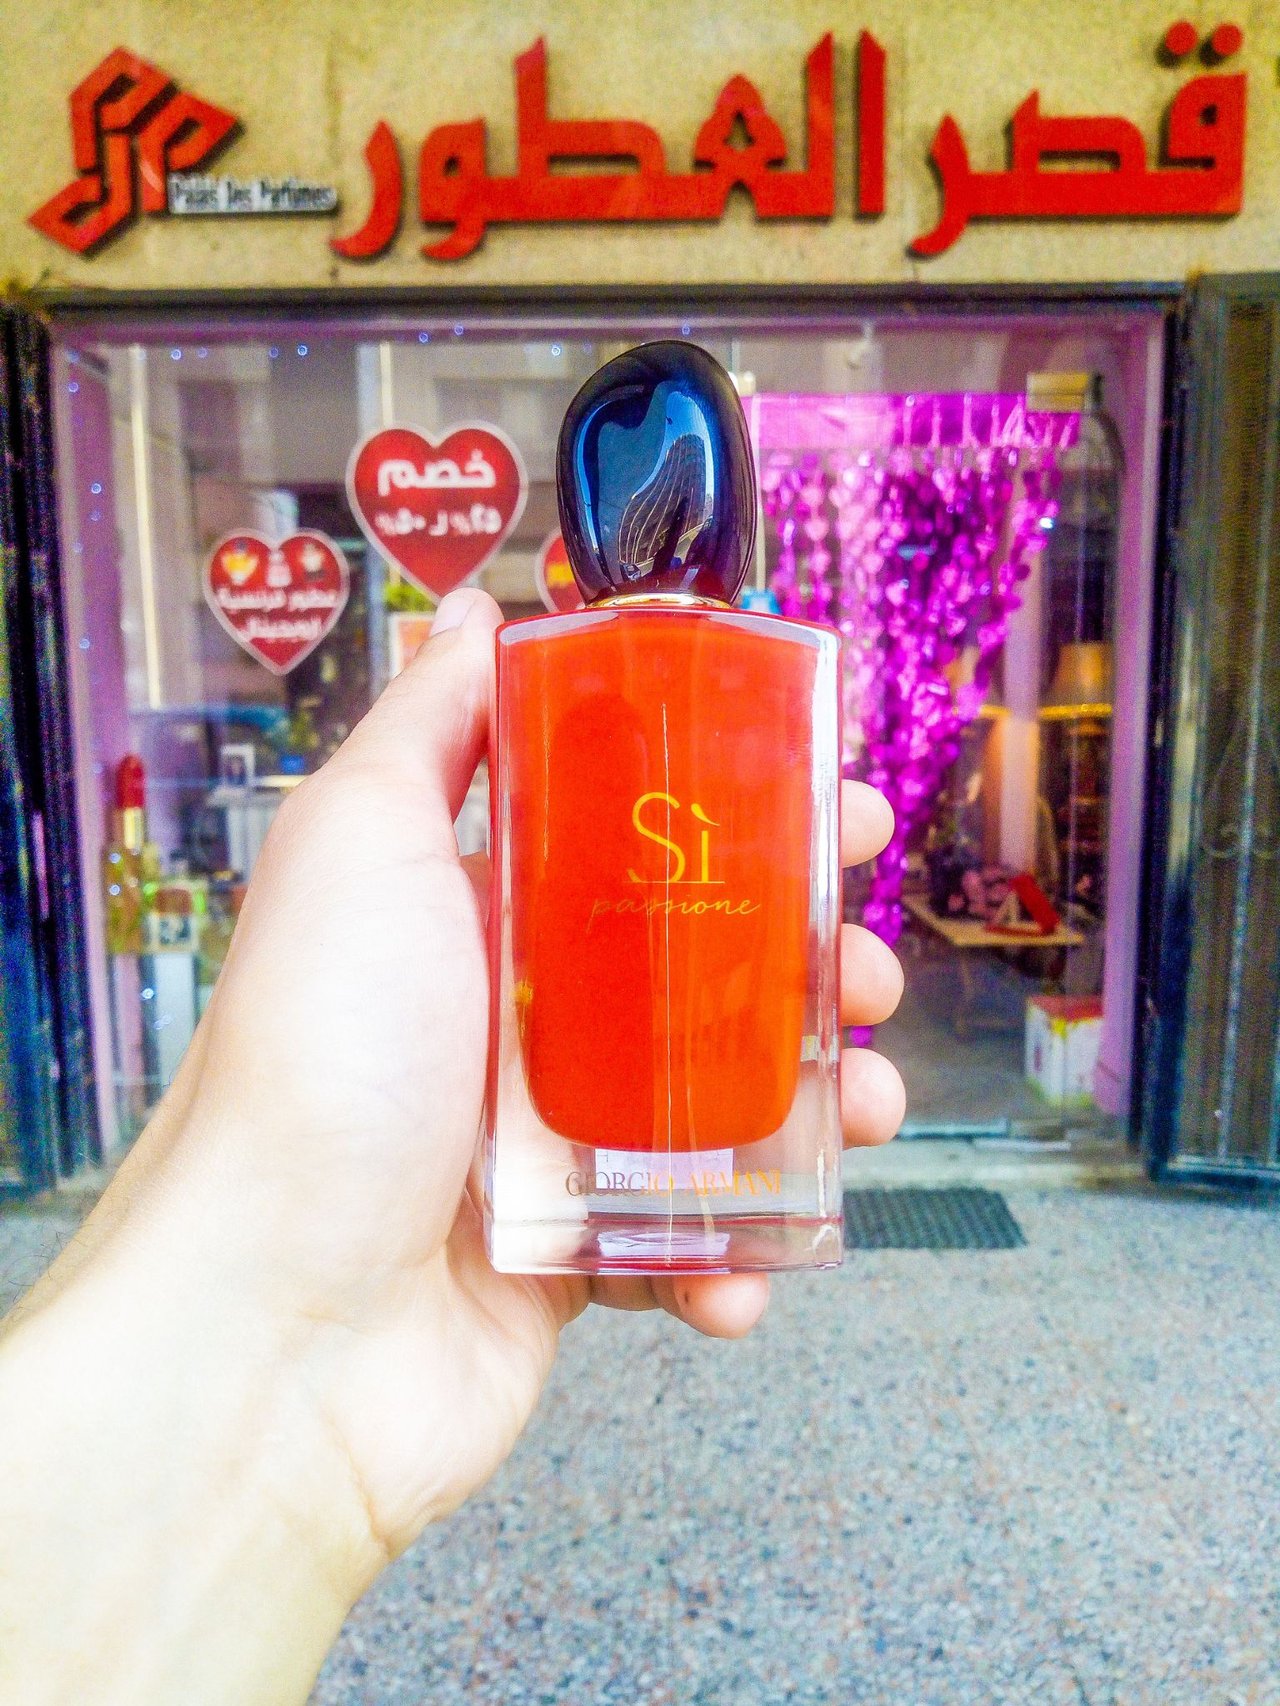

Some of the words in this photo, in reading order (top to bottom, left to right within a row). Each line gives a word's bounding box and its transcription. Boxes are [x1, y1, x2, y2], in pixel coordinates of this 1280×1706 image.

[331, 29, 886, 260] العطور
[908, 21, 1248, 256] قصر
[377, 448, 496, 497] خصم
[584, 894, 762, 935] passione
[565, 1170, 673, 1198] GIORGIO
[686, 1168, 783, 1198] ARMANI
